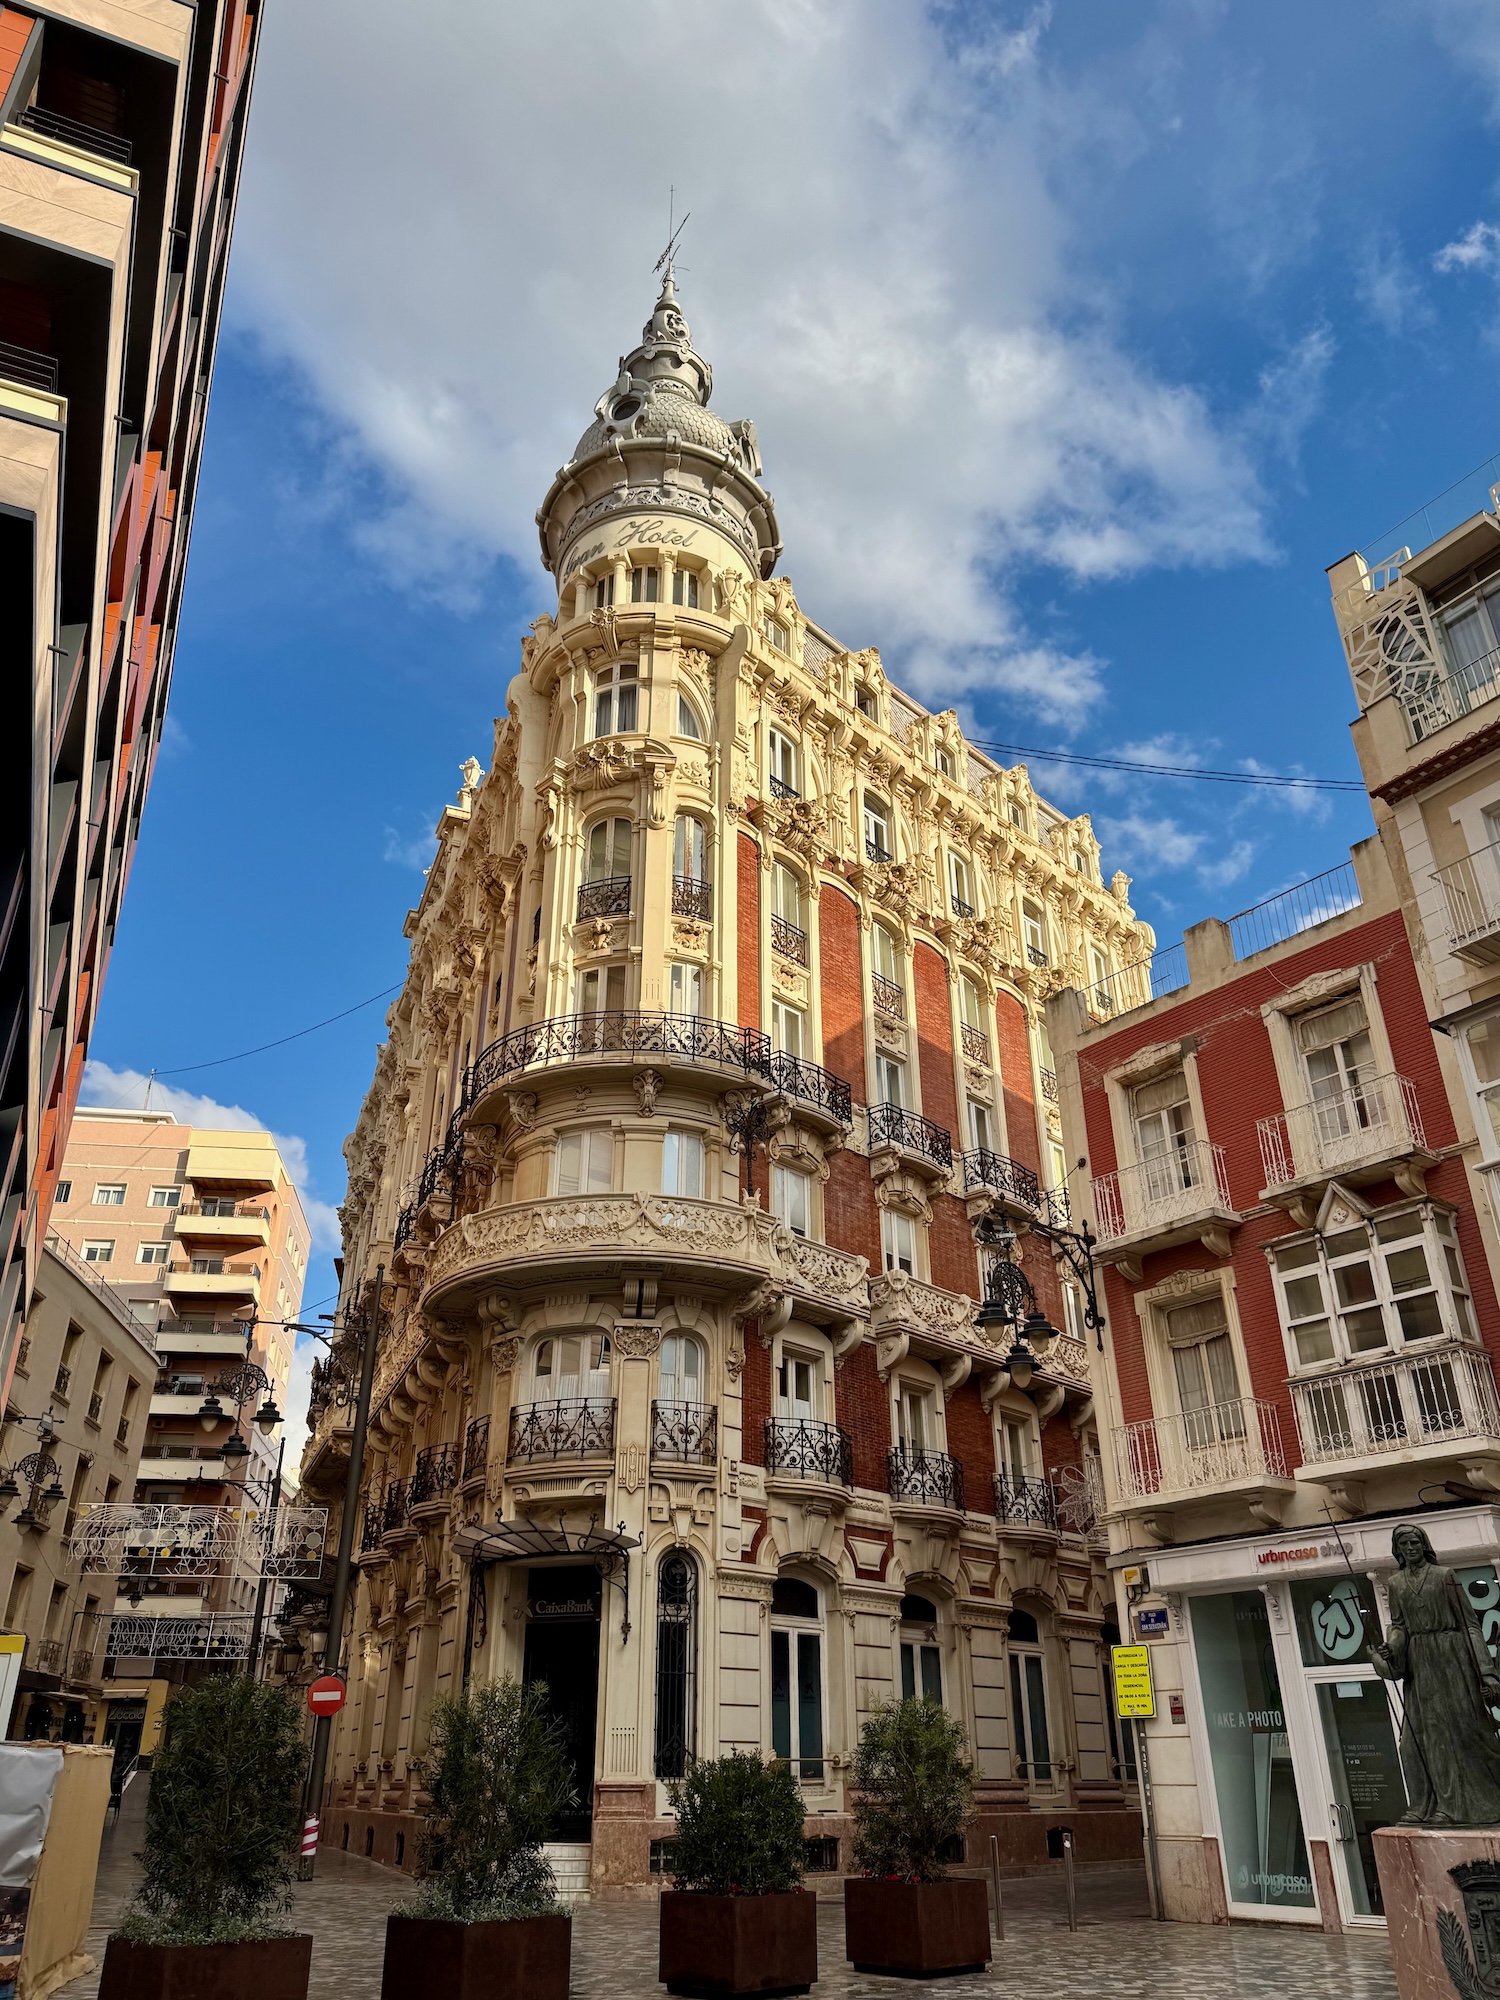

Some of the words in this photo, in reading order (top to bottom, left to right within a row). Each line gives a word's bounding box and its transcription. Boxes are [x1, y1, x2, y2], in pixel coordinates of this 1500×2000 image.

[613, 519, 699, 548] Hotel
[1257, 1546, 1319, 1565] urbincasa
[1320, 1541, 1353, 1557] shop
[535, 1599, 595, 1614] CaixaBank
[1212, 1711, 1237, 1728] TAKE
[1238, 1711, 1246, 1728] A
[1246, 1710, 1283, 1728] PHOTO
[1250, 1871, 1308, 1888] urbincasa
